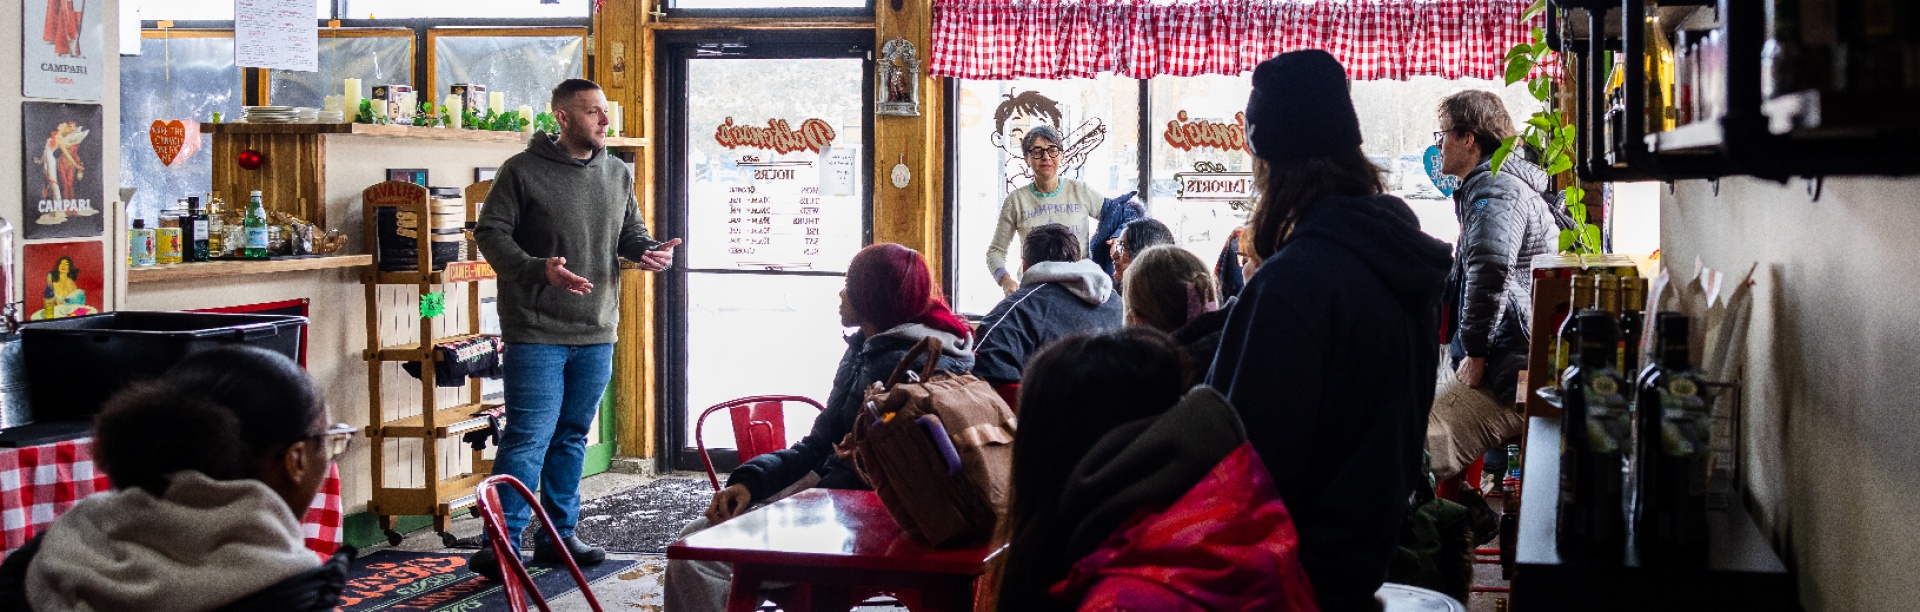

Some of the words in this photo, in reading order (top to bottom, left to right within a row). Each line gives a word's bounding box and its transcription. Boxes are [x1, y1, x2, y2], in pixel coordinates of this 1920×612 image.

[40, 62, 88, 75] CAMPARI
[54, 76, 74, 85] SODA
[365, 182, 424, 205] CAVALIER
[38, 198, 92, 213] CAMPARI
[1023, 203, 1081, 221] CHAMPAGNE
